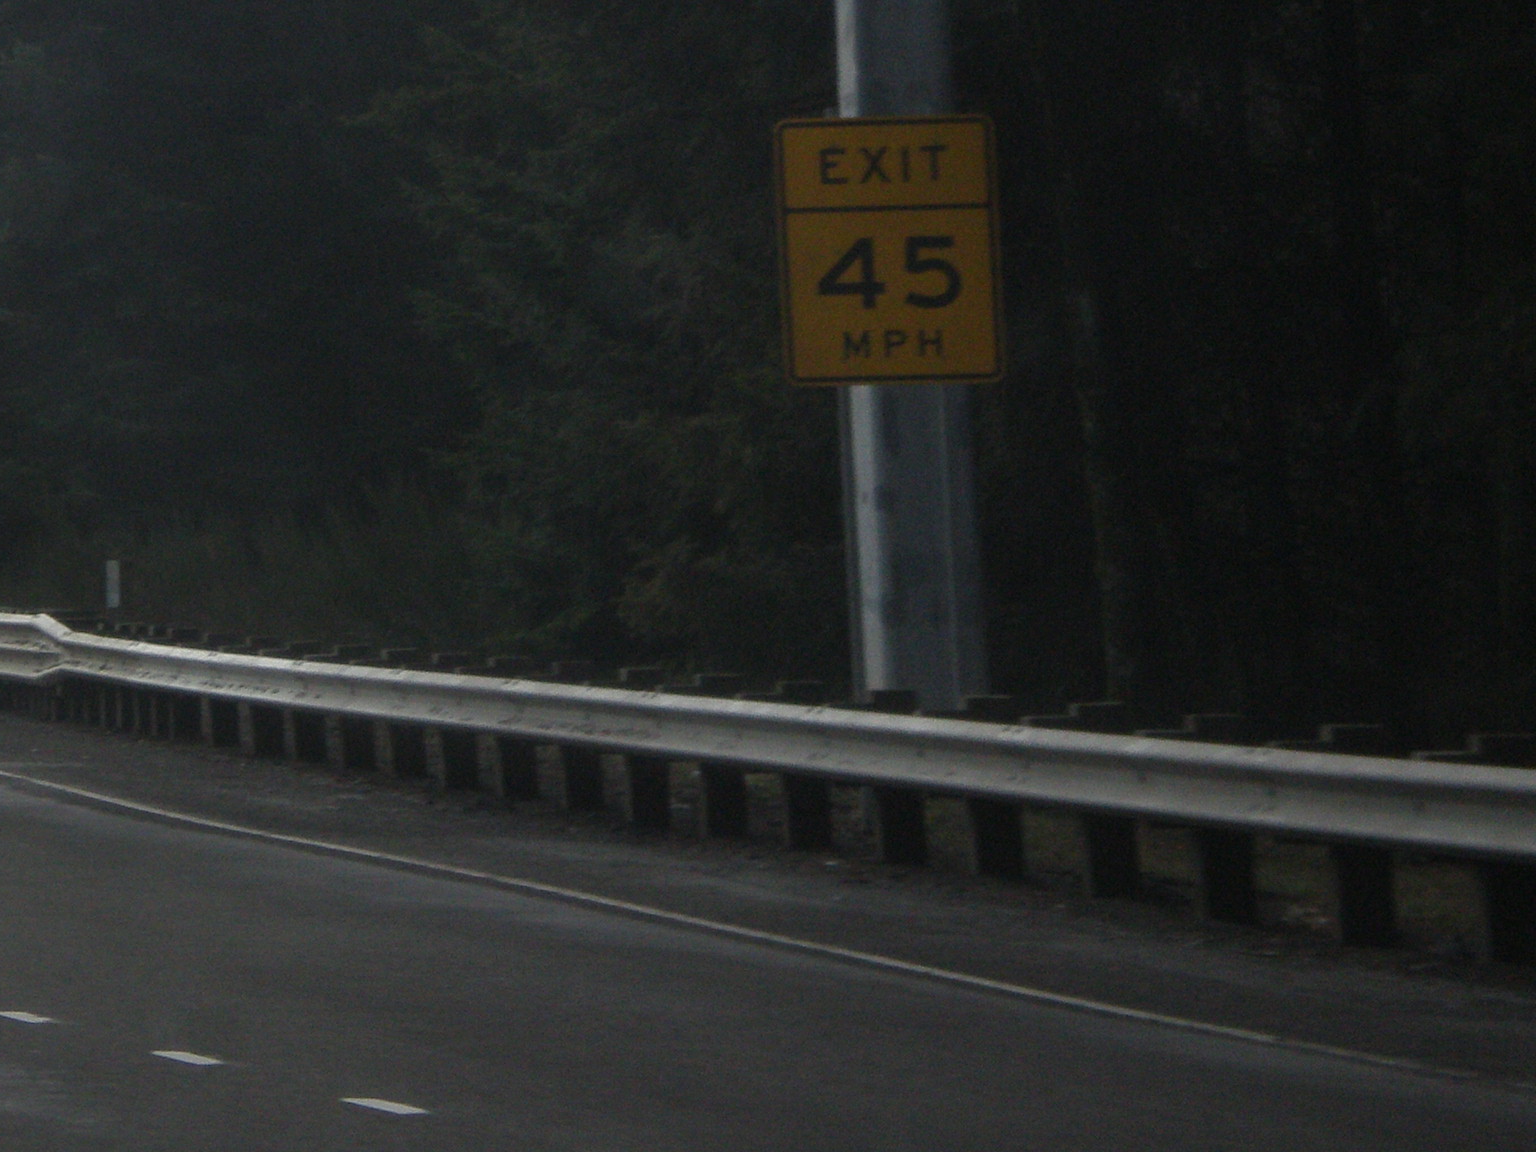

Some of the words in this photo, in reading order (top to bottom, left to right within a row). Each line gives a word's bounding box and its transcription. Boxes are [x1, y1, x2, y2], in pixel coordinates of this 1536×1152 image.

[818, 143, 949, 186] EXIT
[817, 234, 962, 311] 45
[841, 328, 945, 362] MPH
